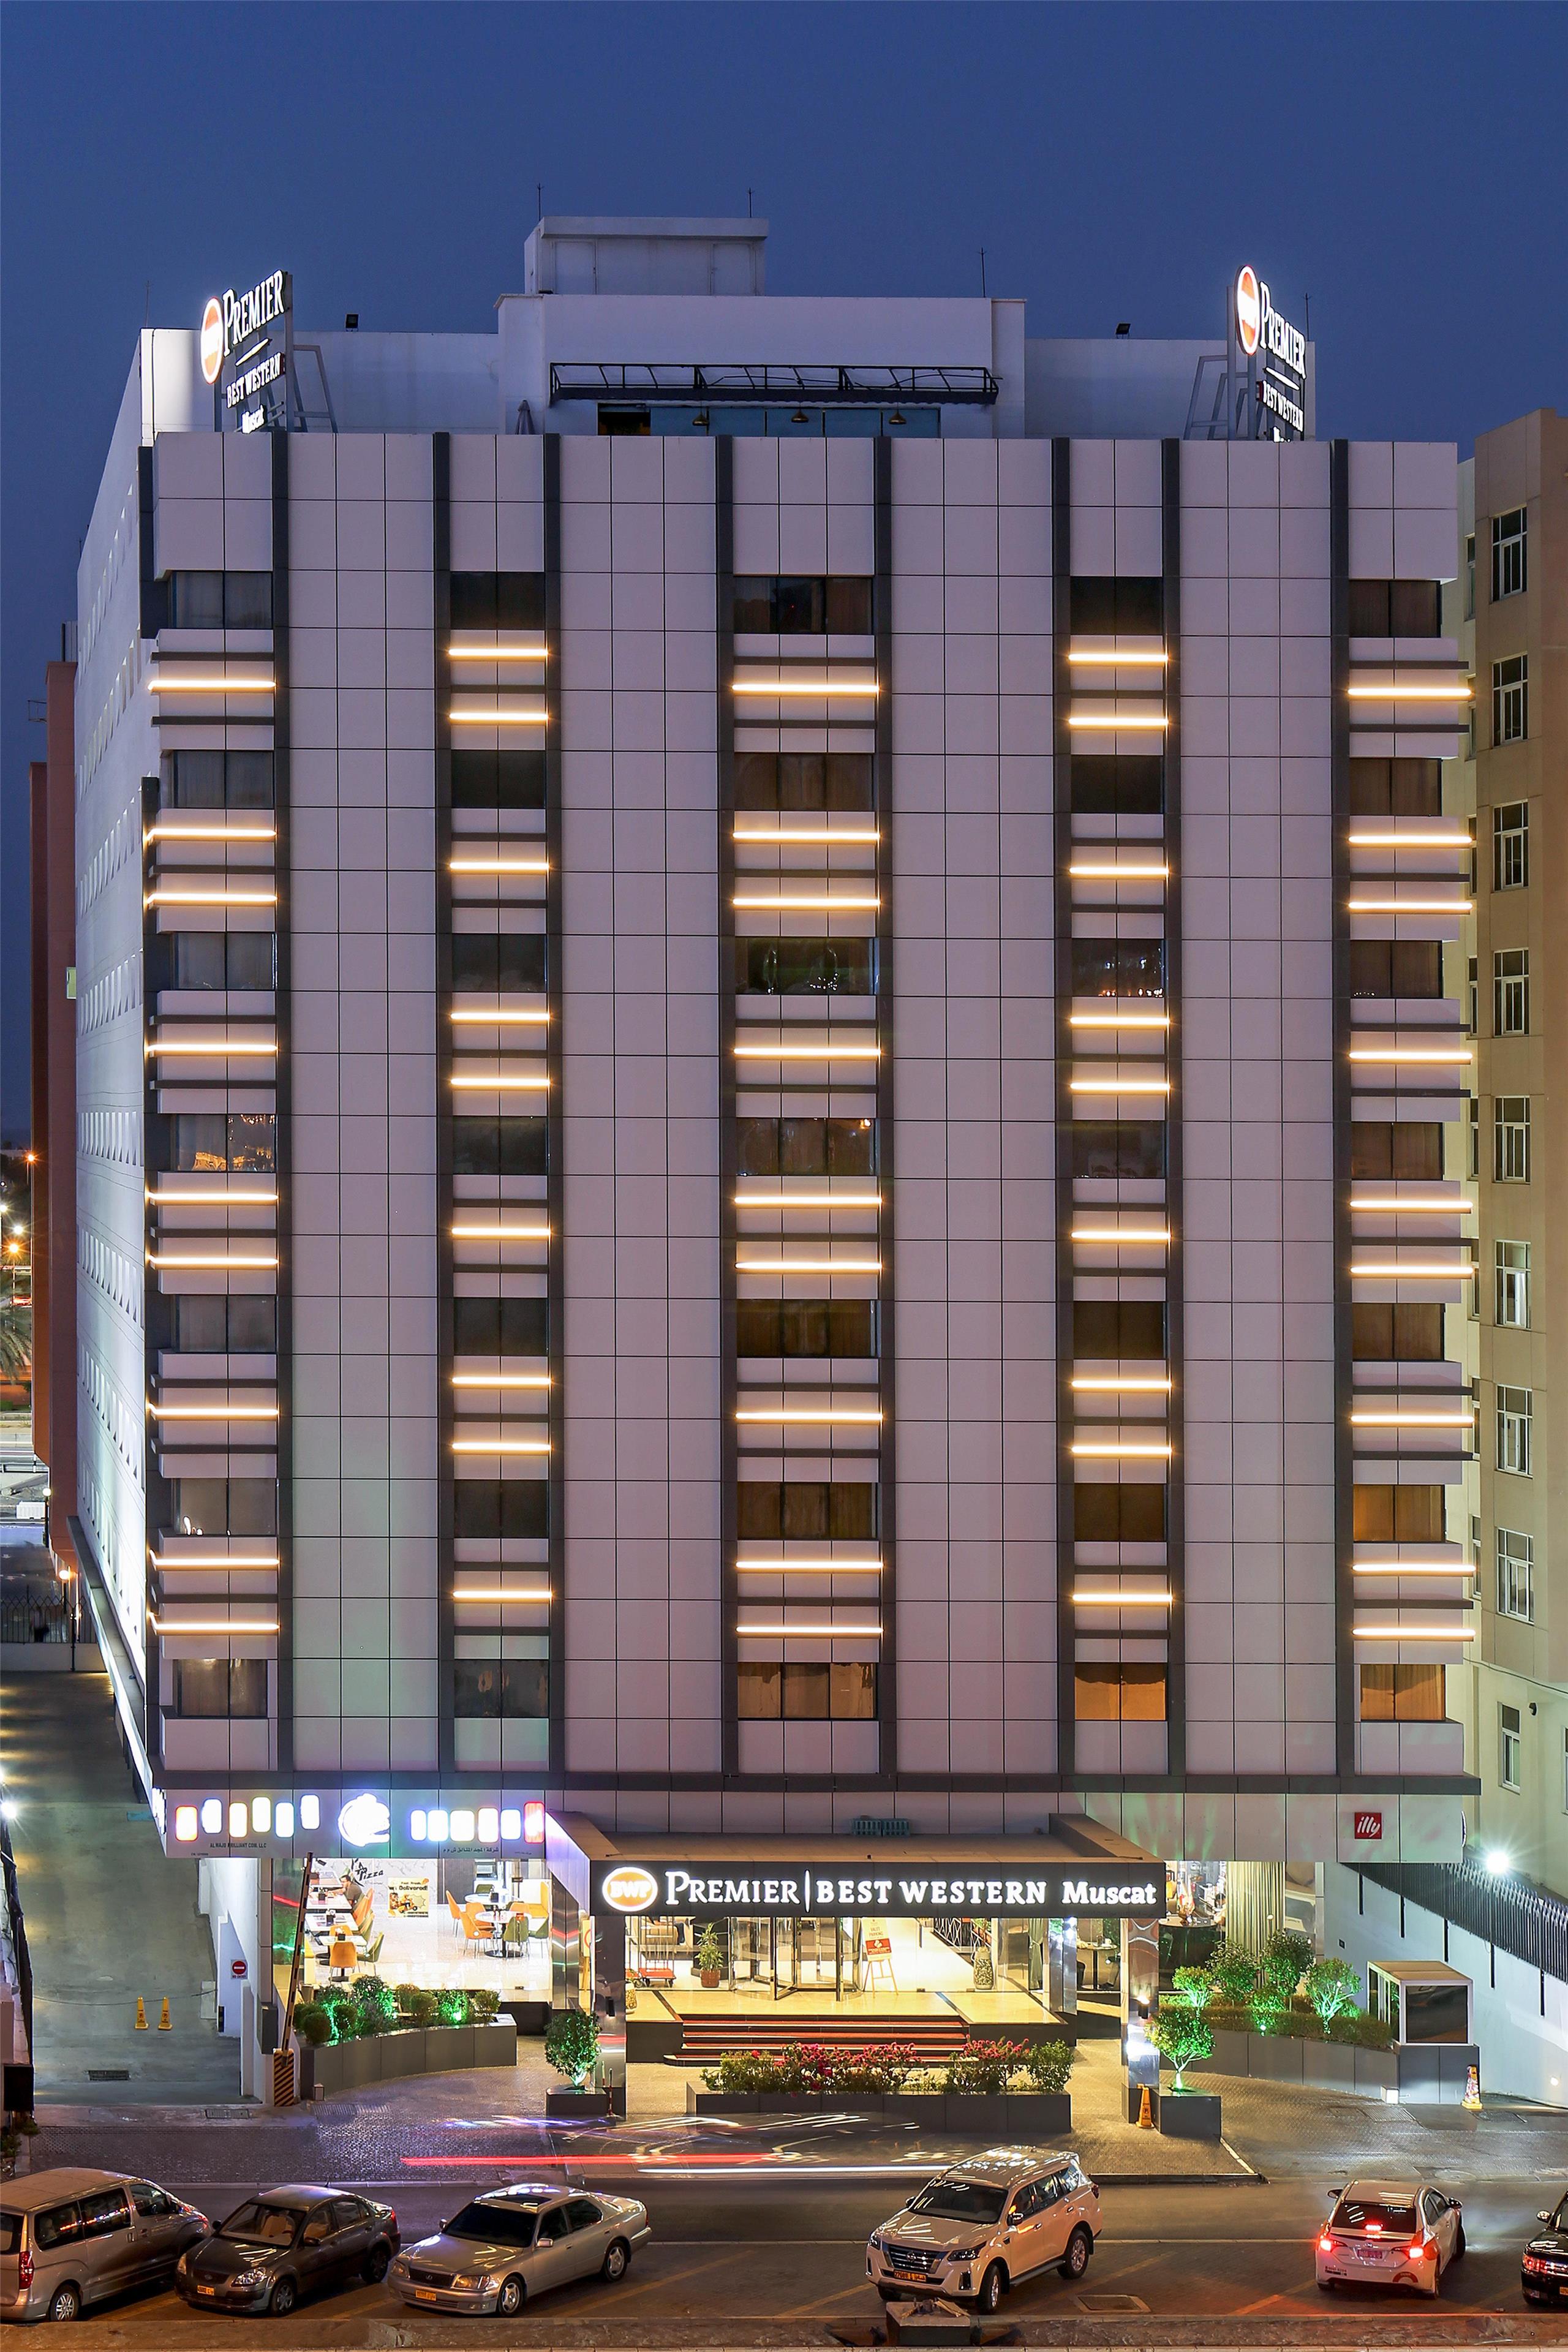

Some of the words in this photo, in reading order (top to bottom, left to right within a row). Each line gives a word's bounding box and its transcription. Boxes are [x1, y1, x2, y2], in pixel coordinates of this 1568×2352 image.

[227, 375, 244, 409] BEST
[244, 352, 281, 396] WESTERN
[1357, 1815, 1381, 1838] illy
[609, 1880, 652, 1898] BWP
[665, 1871, 800, 1905] PREMIER
[815, 1880, 892, 1904] BEST
[898, 1880, 1047, 1905] WESTERN
[1061, 1880, 1157, 1904] Muscat
